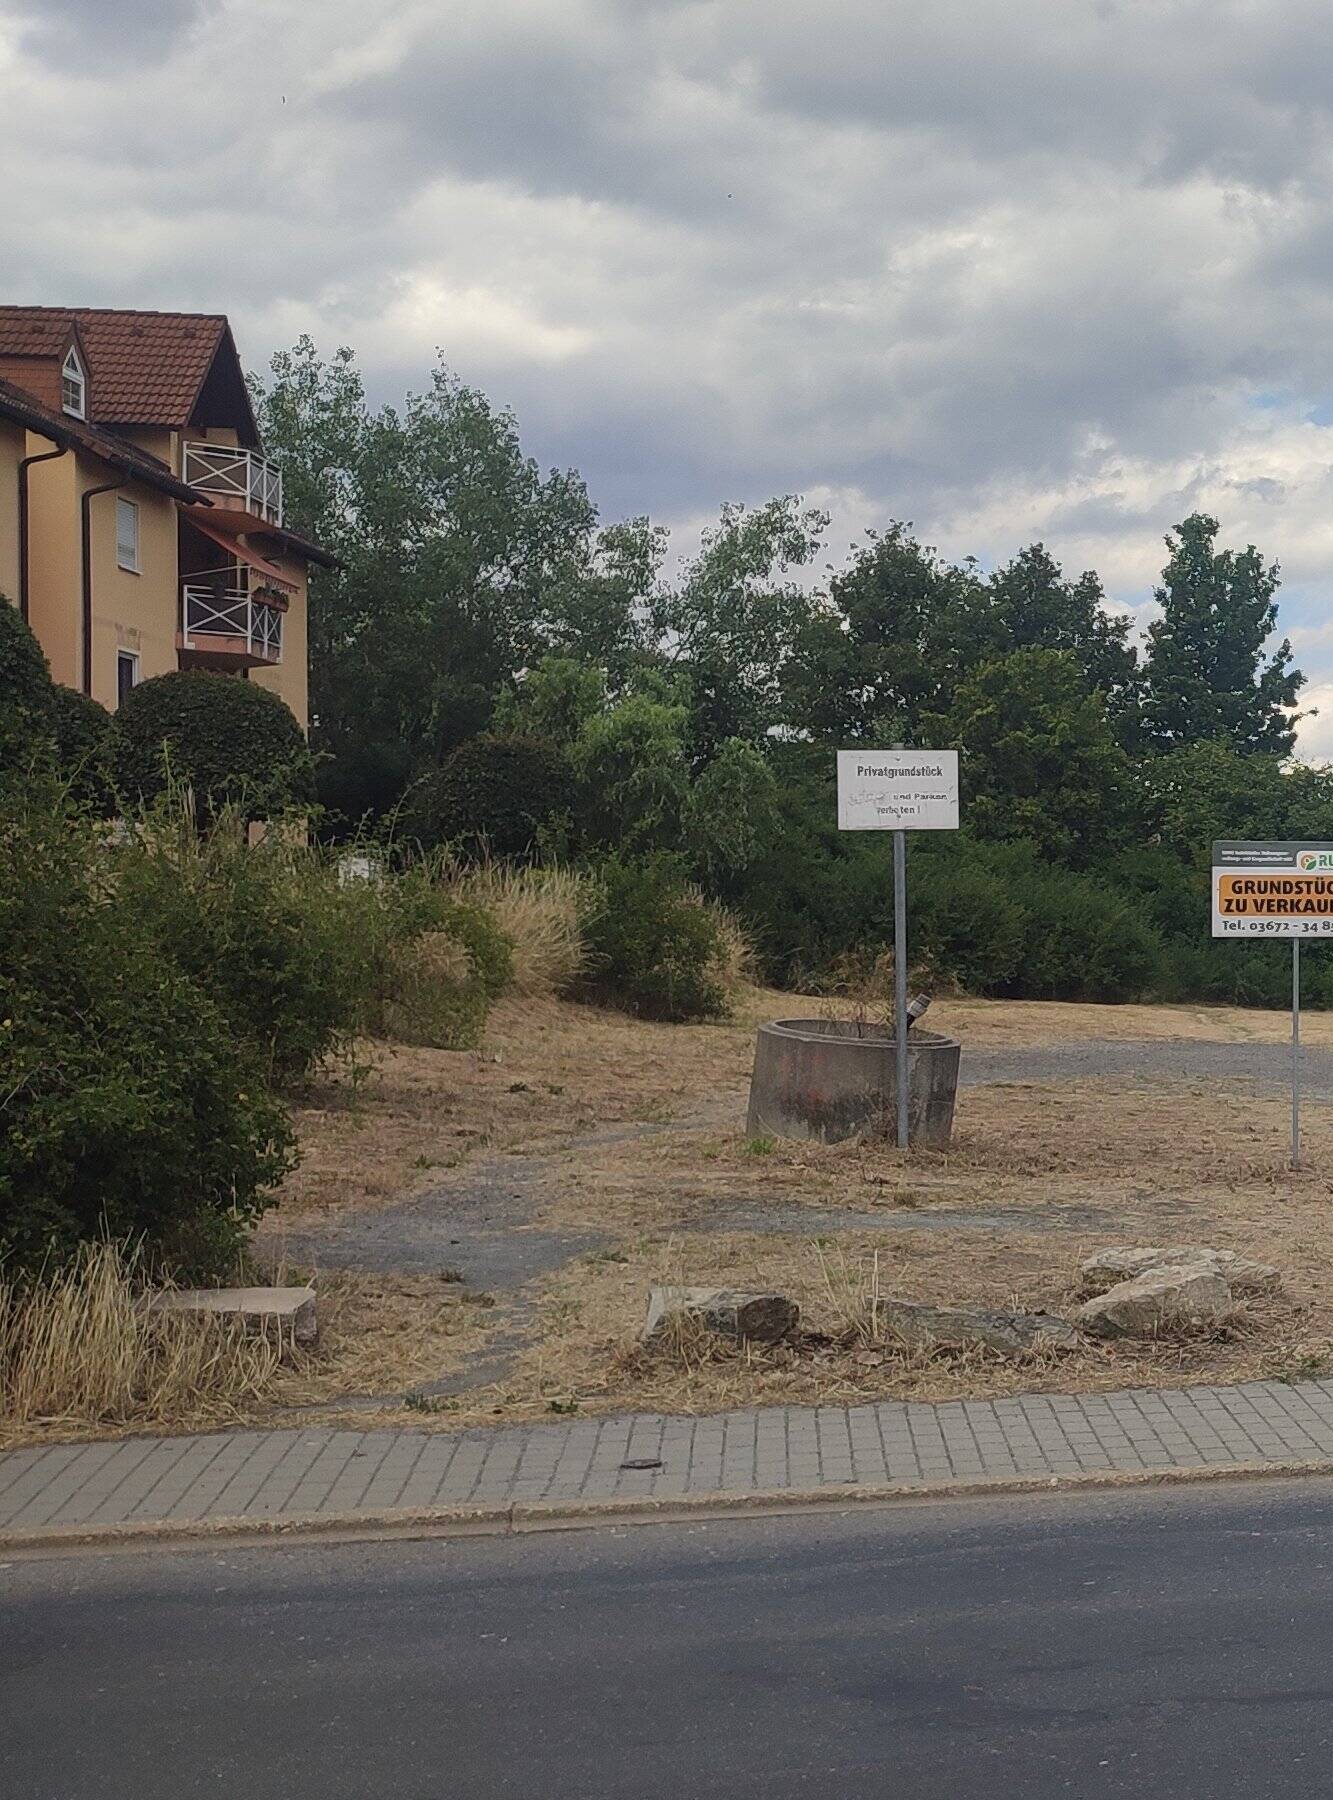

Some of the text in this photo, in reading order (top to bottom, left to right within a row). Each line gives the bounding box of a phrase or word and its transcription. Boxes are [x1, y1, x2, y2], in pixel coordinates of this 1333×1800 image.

[857, 765, 943, 778] Privatgrundstück
[1224, 898, 1248, 913] ZU
[1222, 920, 1245, 931] Tel.
[1249, 921, 1290, 933] 03672
[1301, 922, 1318, 933] 34
